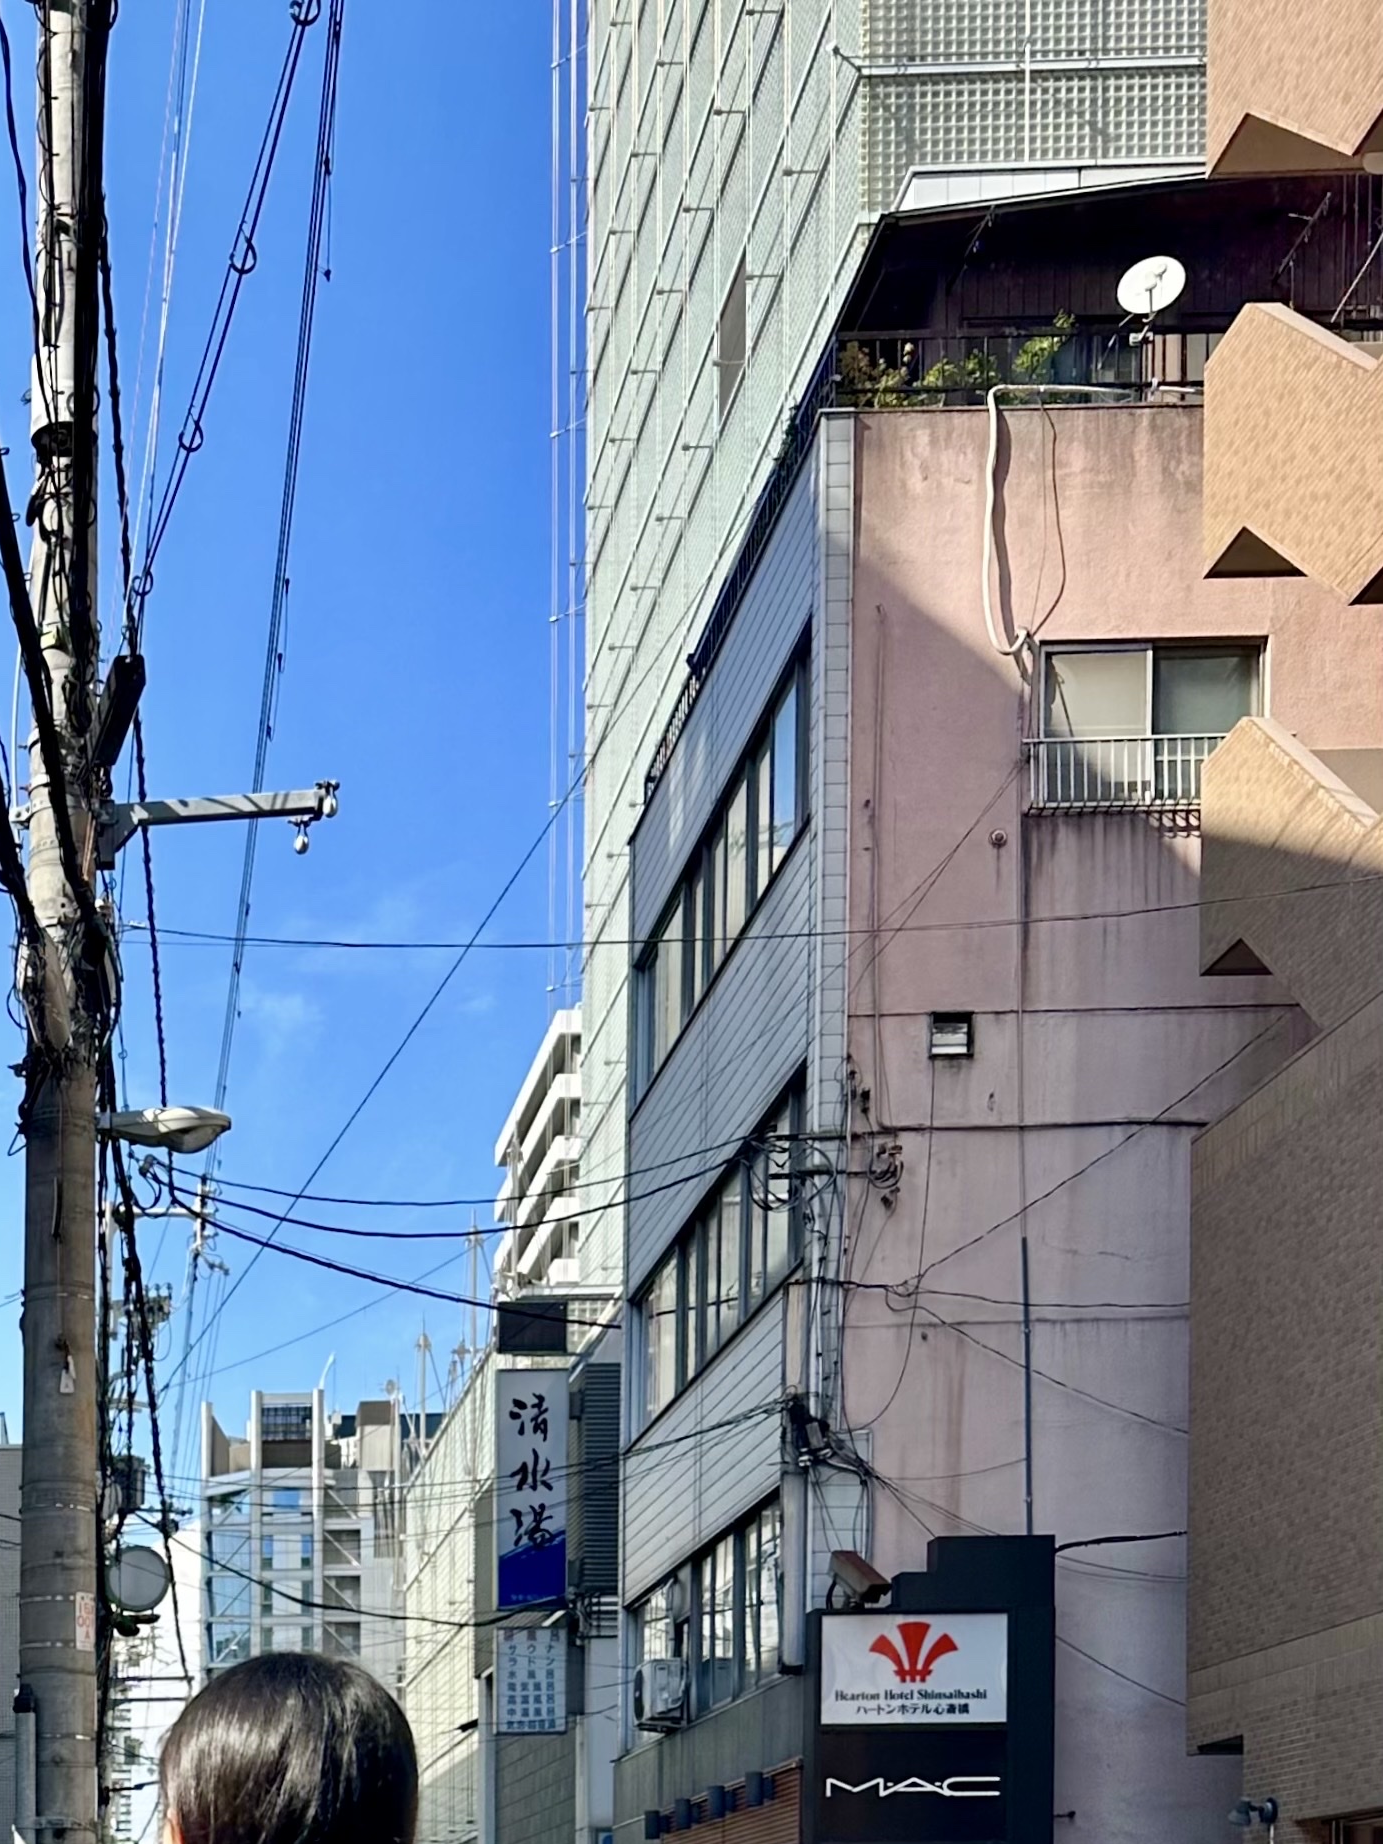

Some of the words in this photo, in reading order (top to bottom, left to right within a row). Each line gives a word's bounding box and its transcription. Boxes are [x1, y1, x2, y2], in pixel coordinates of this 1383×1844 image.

[508, 1392, 554, 1549] 清水湯
[884, 1689, 914, 1701] Hotel
[917, 1688, 987, 1701] Shinsaibashi
